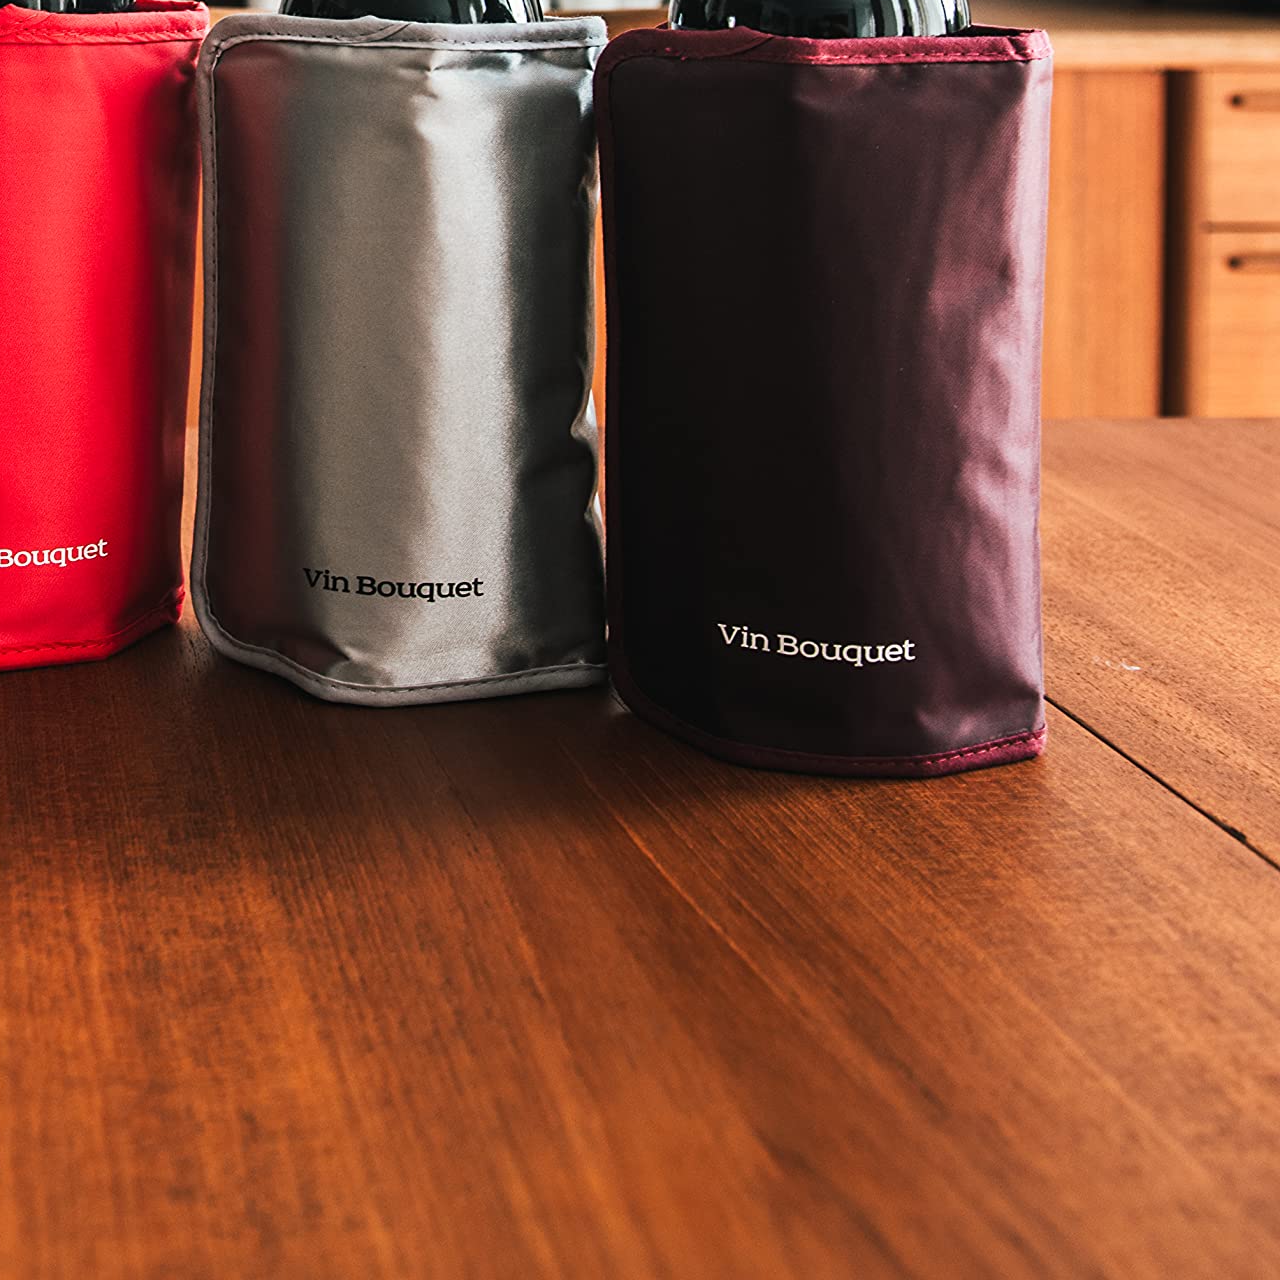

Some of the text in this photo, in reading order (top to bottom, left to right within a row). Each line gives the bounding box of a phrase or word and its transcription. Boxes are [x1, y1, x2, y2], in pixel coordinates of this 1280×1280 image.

[302, 567, 484, 602] Vin Bouquet
[717, 623, 916, 667] Vin Bouquet
